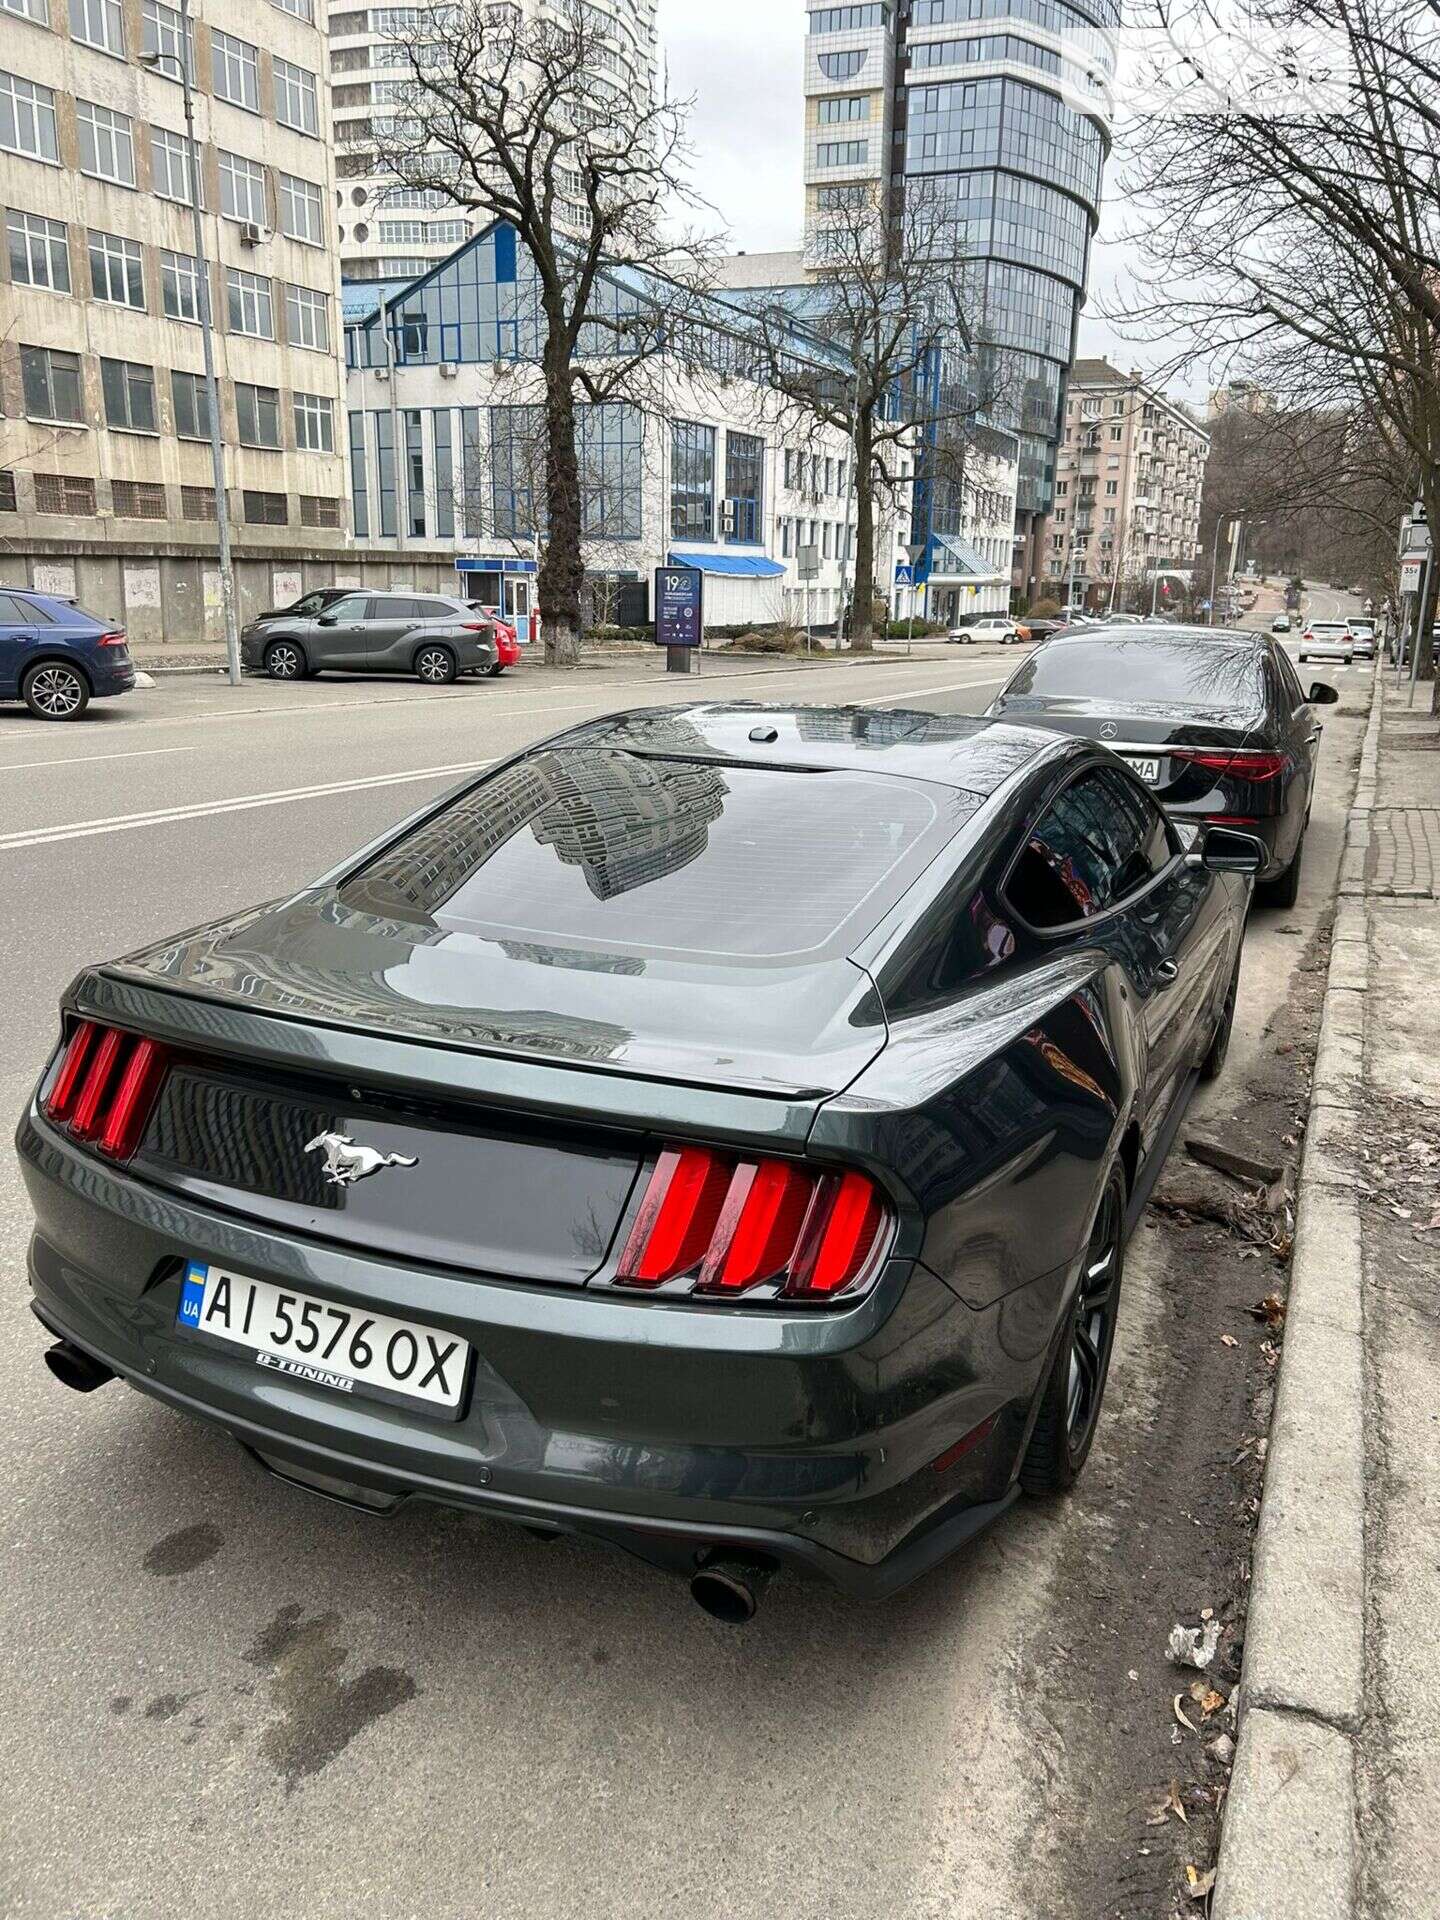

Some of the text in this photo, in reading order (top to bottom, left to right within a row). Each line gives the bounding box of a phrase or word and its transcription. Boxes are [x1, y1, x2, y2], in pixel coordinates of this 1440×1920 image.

[183, 1299, 199, 1319] UA
[269, 1293, 376, 1369] 5576
[386, 1328, 460, 1396] OX
